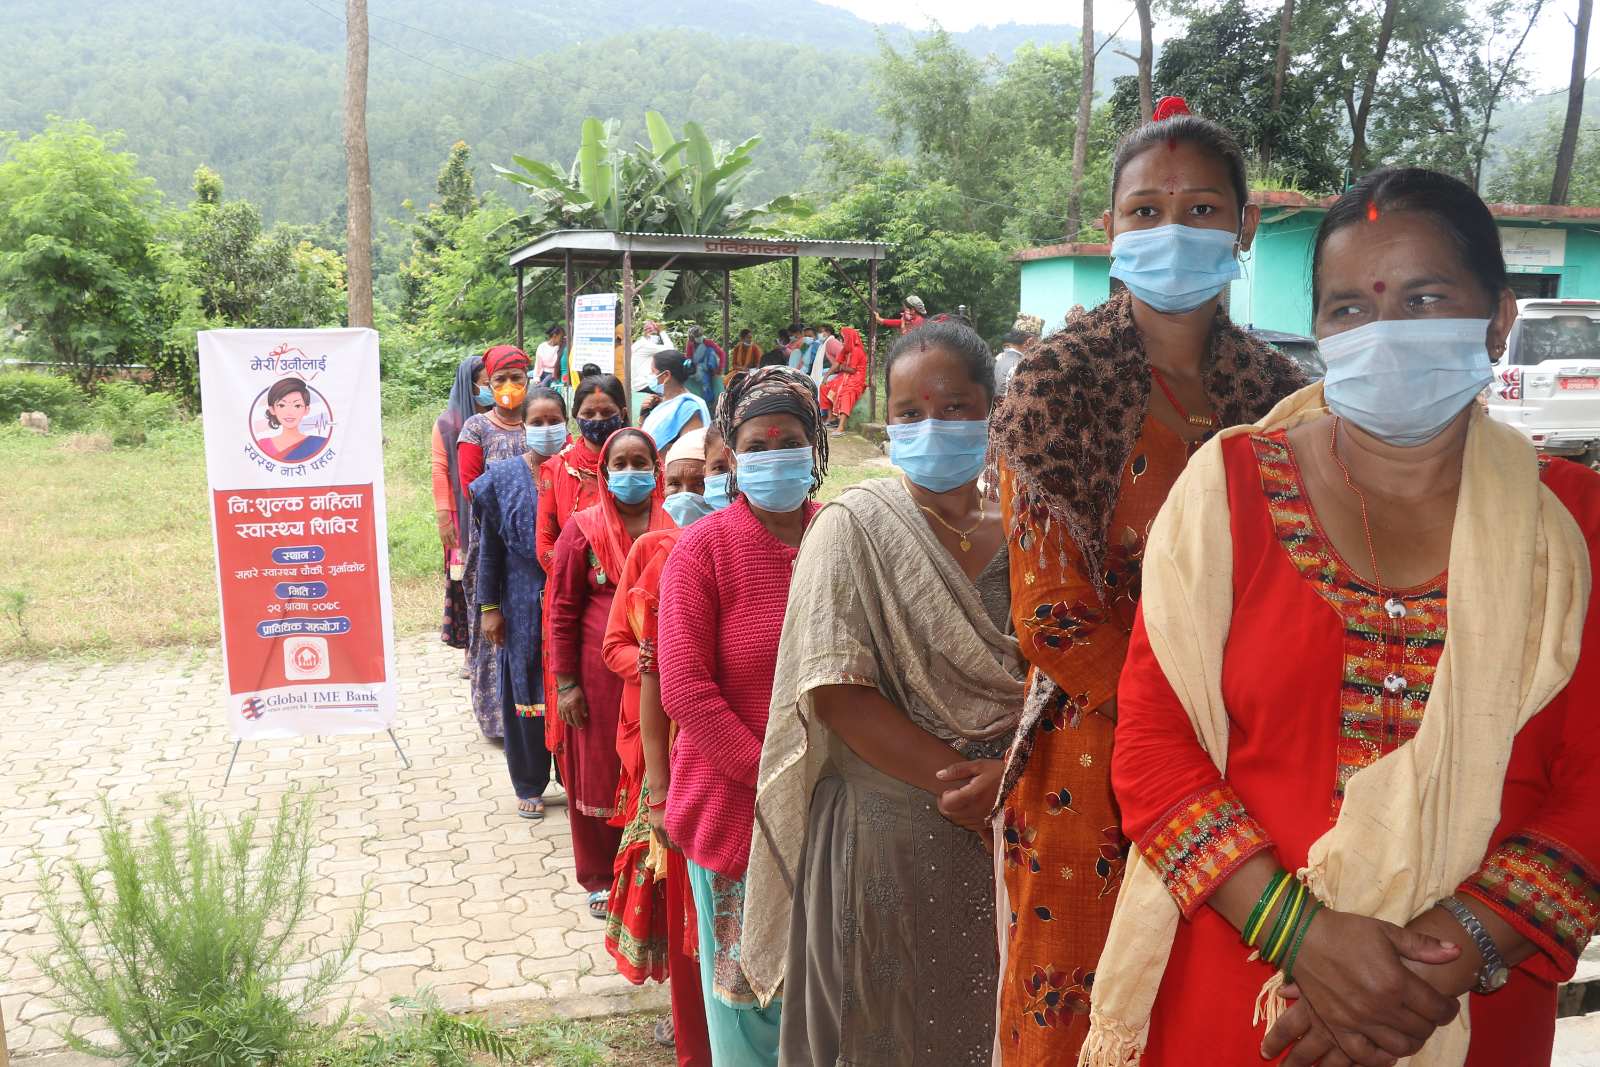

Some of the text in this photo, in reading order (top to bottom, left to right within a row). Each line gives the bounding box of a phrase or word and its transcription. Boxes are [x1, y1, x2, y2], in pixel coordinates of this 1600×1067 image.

[250, 355, 275, 371] मेरी
[244, 443, 336, 477] स्वस्थ नारी पहल
[309, 491, 363, 511] महिला
[234, 516, 359, 538] स्वास्थ्य शिविर
[282, 550, 309, 560] स्थान
[288, 585, 309, 596] मिति
[262, 621, 302, 636] प्राविधिक
[266, 690, 377, 707] Global IME Bank
